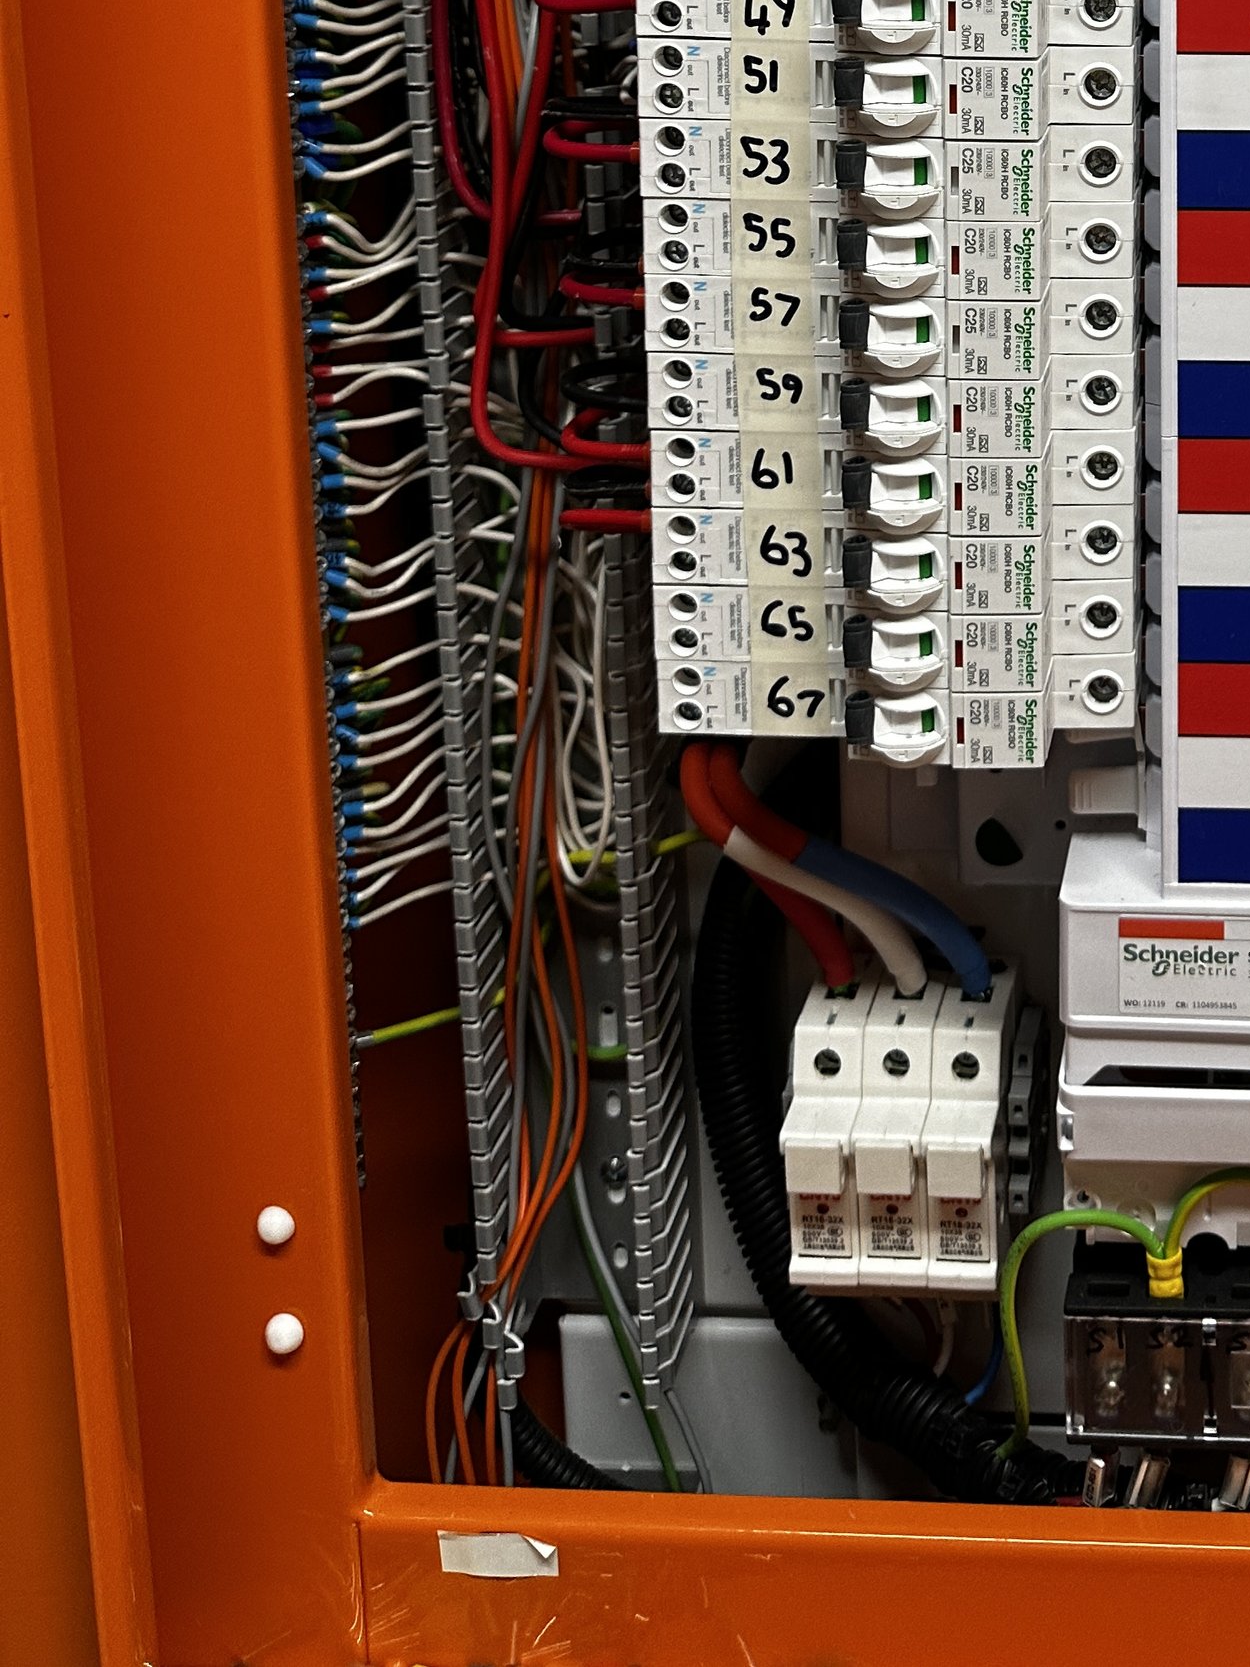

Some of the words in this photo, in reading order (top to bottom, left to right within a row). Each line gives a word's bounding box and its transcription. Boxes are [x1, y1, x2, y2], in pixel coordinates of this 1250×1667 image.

[743, 55, 778, 94] 51
[962, 67, 973, 93] C20
[962, 108, 971, 134] 30mA
[1022, 68, 1033, 135] Schneider
[740, 136, 790, 185] 53
[962, 148, 974, 174] C25
[1022, 150, 1033, 216] Schneider
[743, 213, 795, 258] 55
[965, 228, 976, 254] C20
[1023, 228, 1035, 294] Schneider
[749, 287, 800, 326] 57
[965, 308, 977, 333] C25
[1023, 307, 1035, 373] Schneider
[756, 368, 803, 404] 59
[966, 387, 978, 412] C20
[1024, 387, 1035, 452] Schneider
[751, 448, 793, 489] 61
[967, 466, 978, 491] C20
[1026, 465, 1037, 530] Schneider
[760, 525, 812, 577] 63
[966, 544, 977, 568] C20
[1023, 545, 1035, 610] Schneider
[966, 622, 978, 647] C20
[1026, 623, 1037, 687] Schneider
[767, 676, 825, 718] 67
[970, 700, 981, 725] C20
[970, 738, 980, 763] 30mA
[1026, 700, 1037, 763] Schneider
[1123, 943, 1239, 964] Schneider
[1174, 964, 1236, 977] Electric
